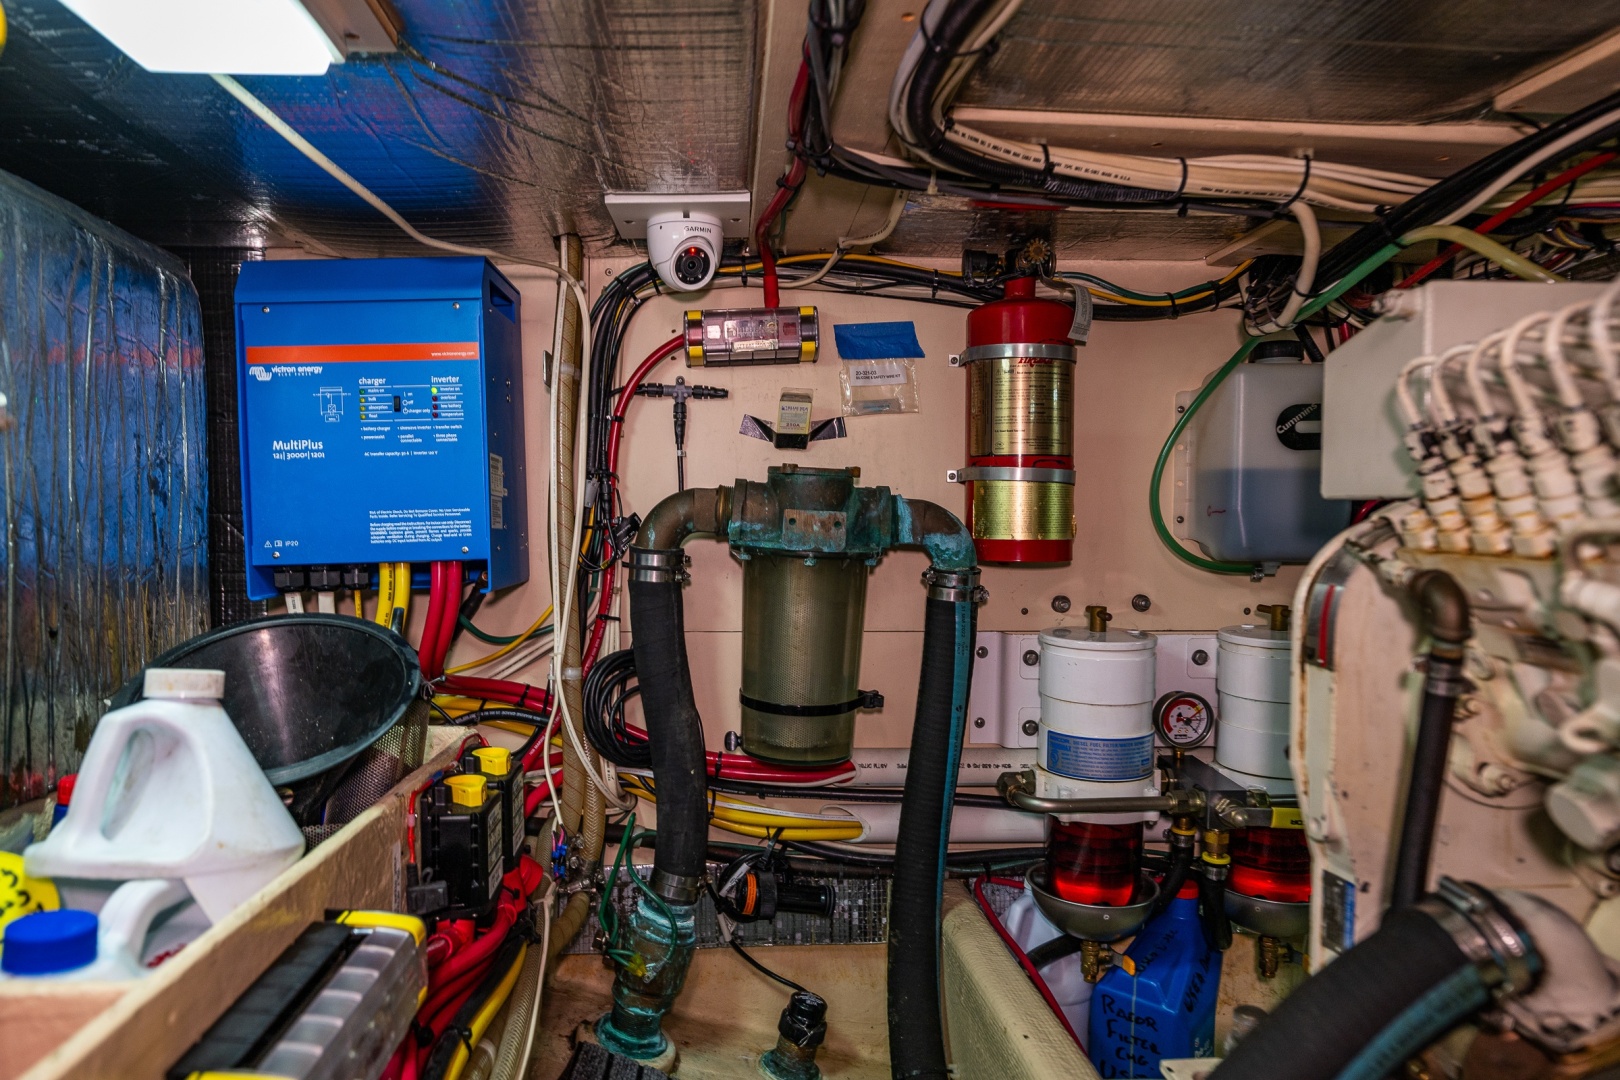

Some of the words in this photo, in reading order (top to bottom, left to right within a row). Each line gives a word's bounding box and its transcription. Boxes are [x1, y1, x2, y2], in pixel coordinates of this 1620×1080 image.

[684, 226, 712, 234] GARMIN
[298, 366, 322, 374] energy
[359, 377, 386, 386] charger
[1276, 402, 1318, 434] Cummins
[272, 440, 323, 450] MultiPlus
